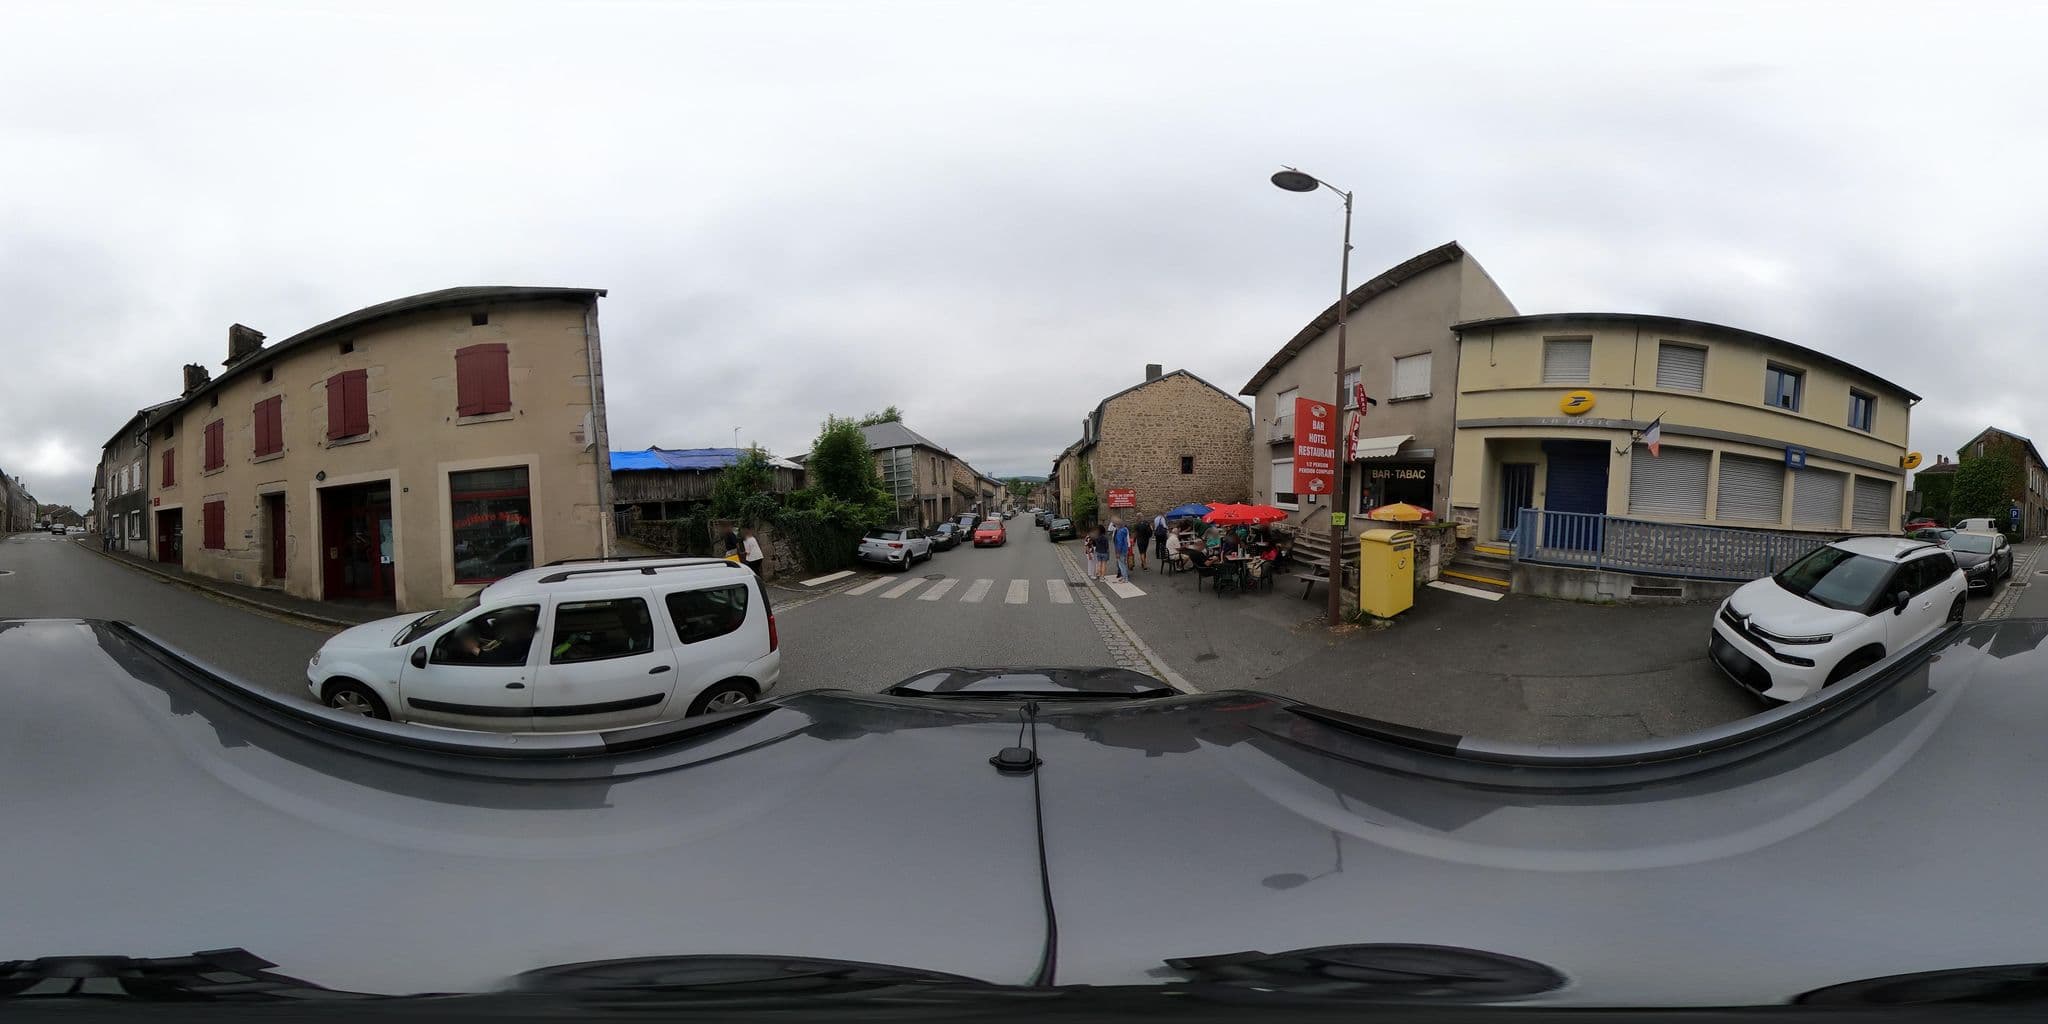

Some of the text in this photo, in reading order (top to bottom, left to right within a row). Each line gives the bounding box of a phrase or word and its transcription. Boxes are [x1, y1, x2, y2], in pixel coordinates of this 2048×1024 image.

[1312, 420, 1325, 431] BAR
[1309, 433, 1327, 445] HOTEL
[1298, 445, 1335, 459] RESTAURANT
[1372, 469, 1391, 479] BAR
[1395, 469, 1426, 480] TABAC
